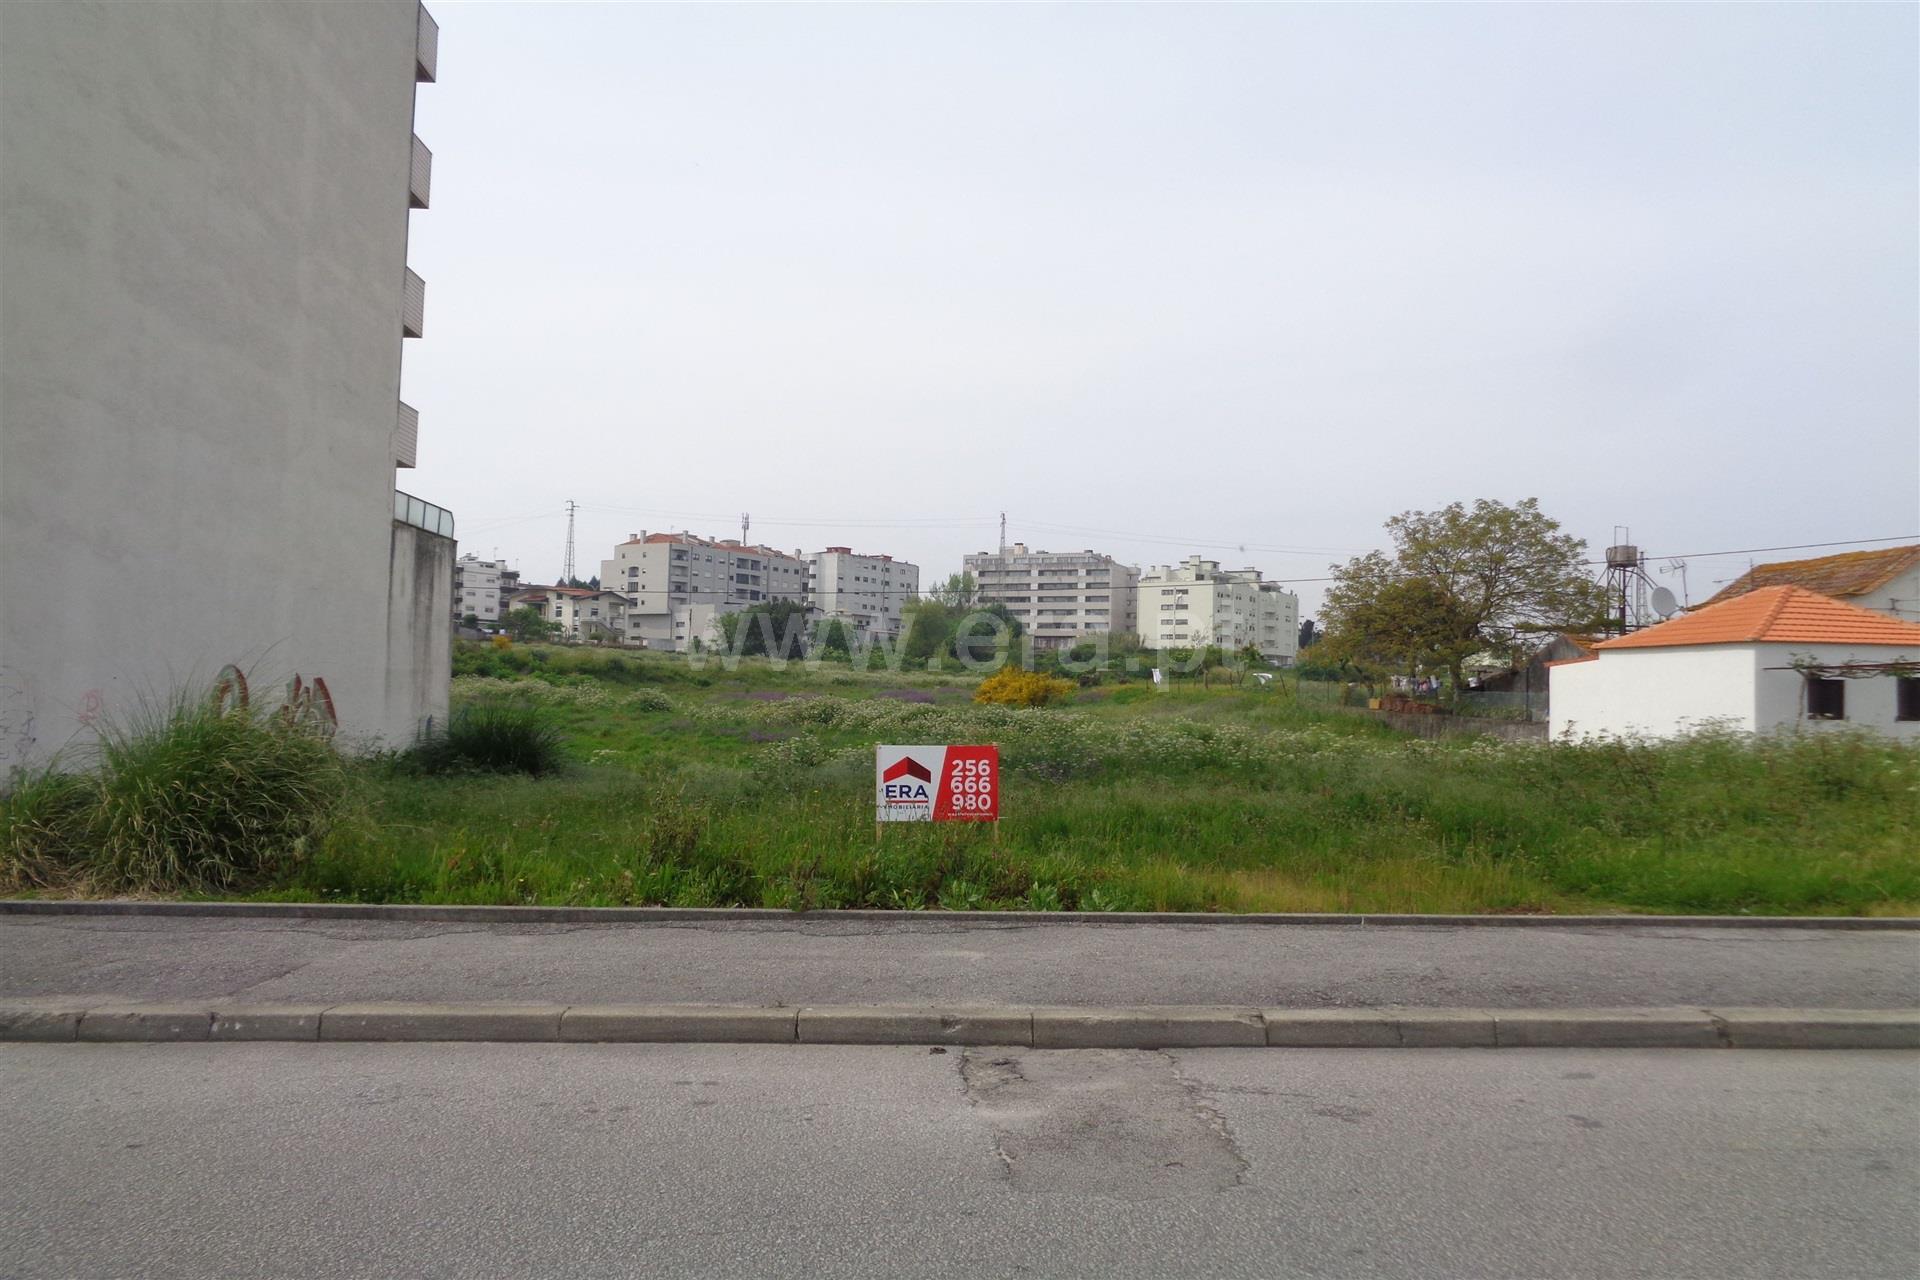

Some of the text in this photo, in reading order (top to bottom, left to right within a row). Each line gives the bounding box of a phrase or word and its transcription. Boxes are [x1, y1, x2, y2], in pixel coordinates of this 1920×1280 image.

[951, 759, 991, 776] 256
[885, 784, 928, 799] ERA
[950, 777, 991, 793] 666
[951, 794, 991, 810] 980
